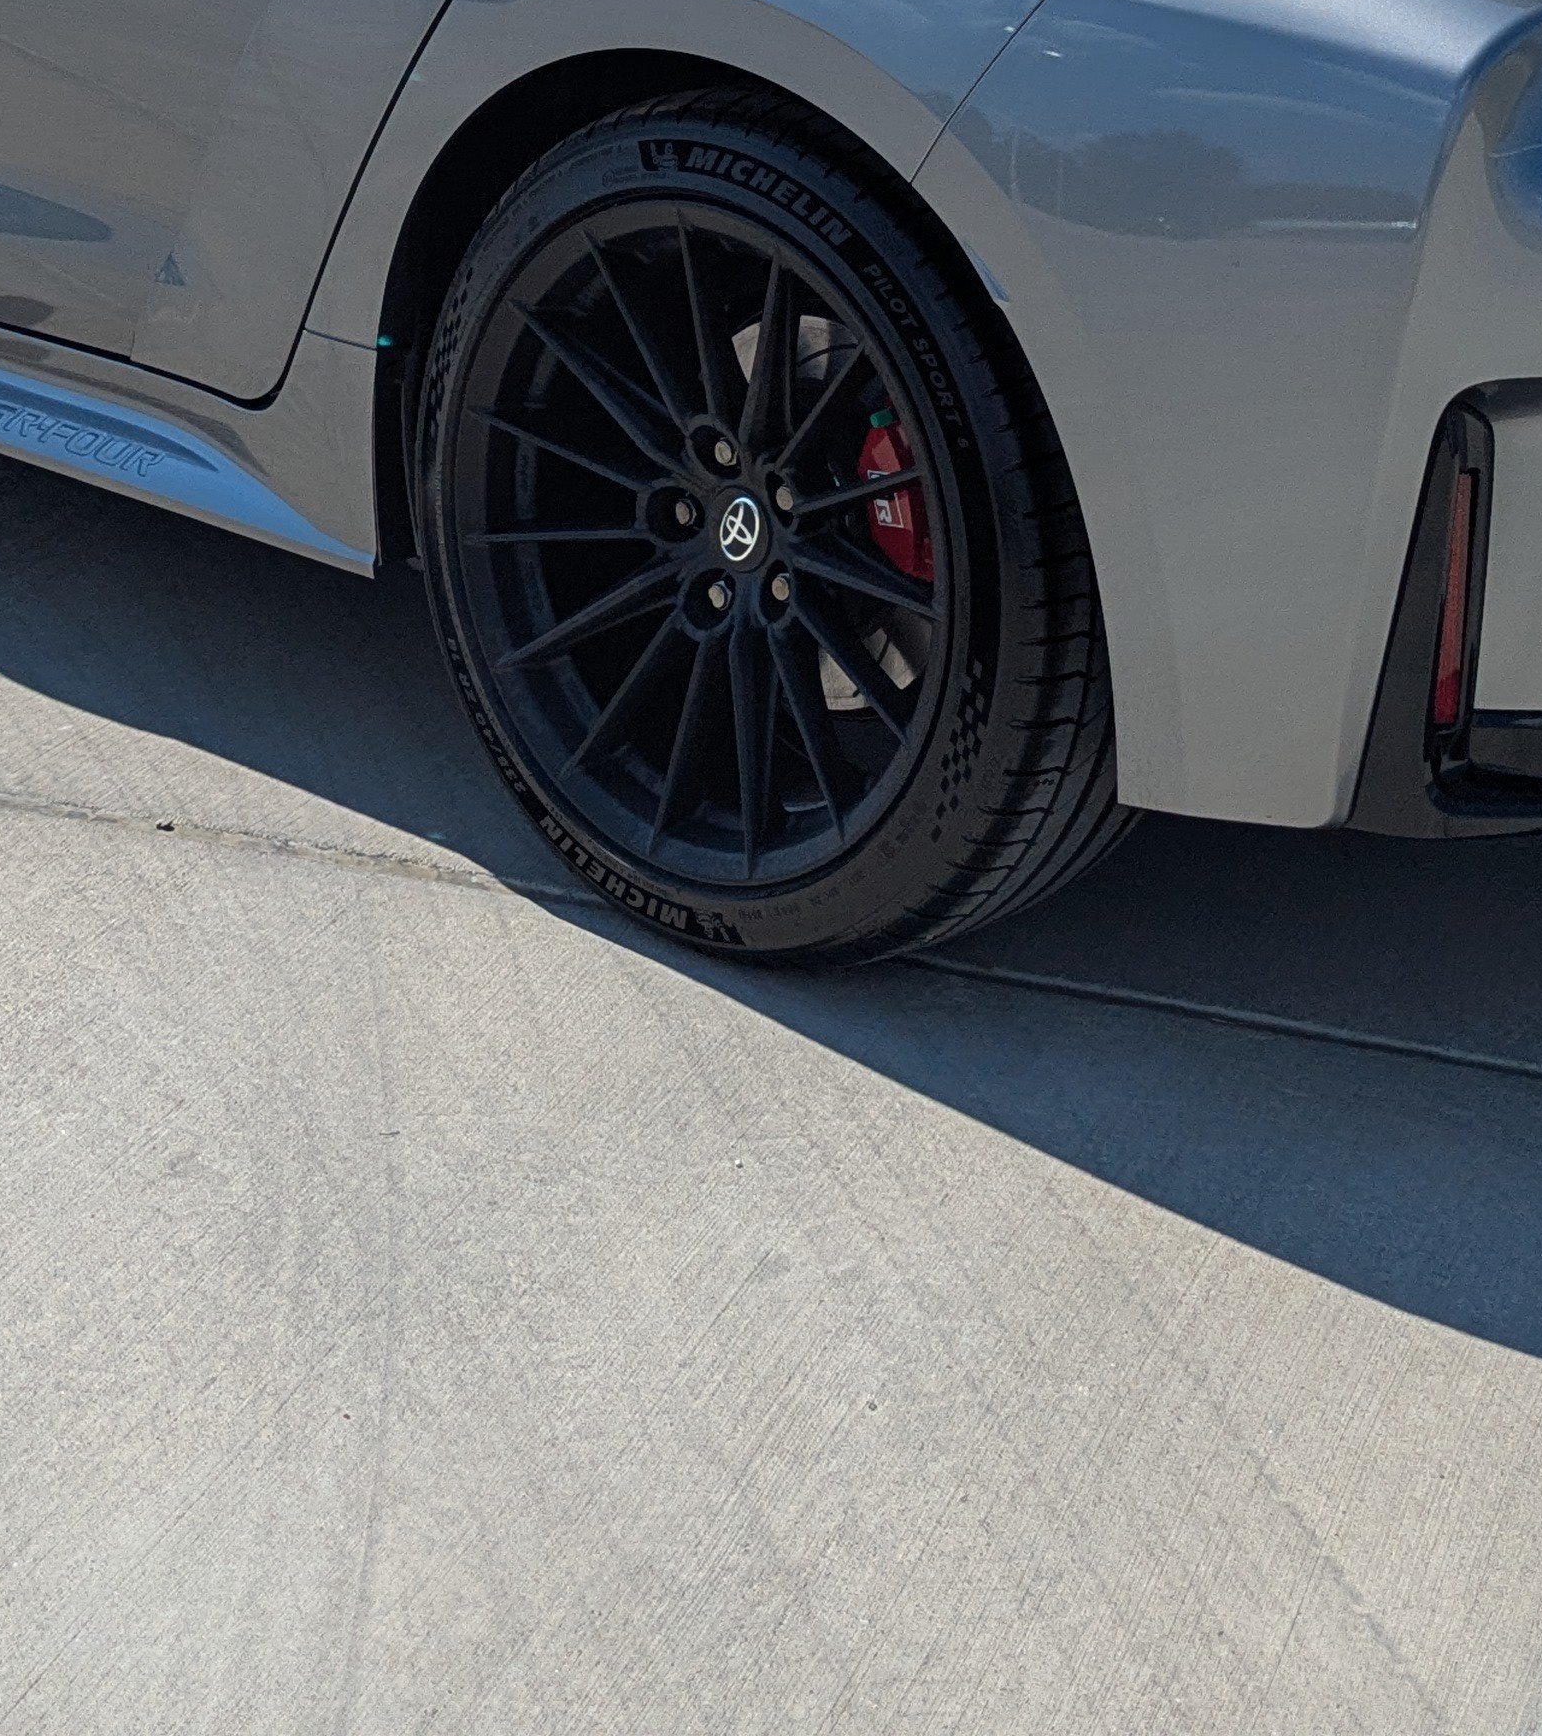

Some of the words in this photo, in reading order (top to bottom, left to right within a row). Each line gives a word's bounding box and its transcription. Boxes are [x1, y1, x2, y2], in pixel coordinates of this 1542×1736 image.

[685, 146, 852, 246] MICHELIN
[863, 263, 919, 327] PILOT
[913, 338, 963, 426] SPORT
[540, 815, 687, 930] MICHELIN
